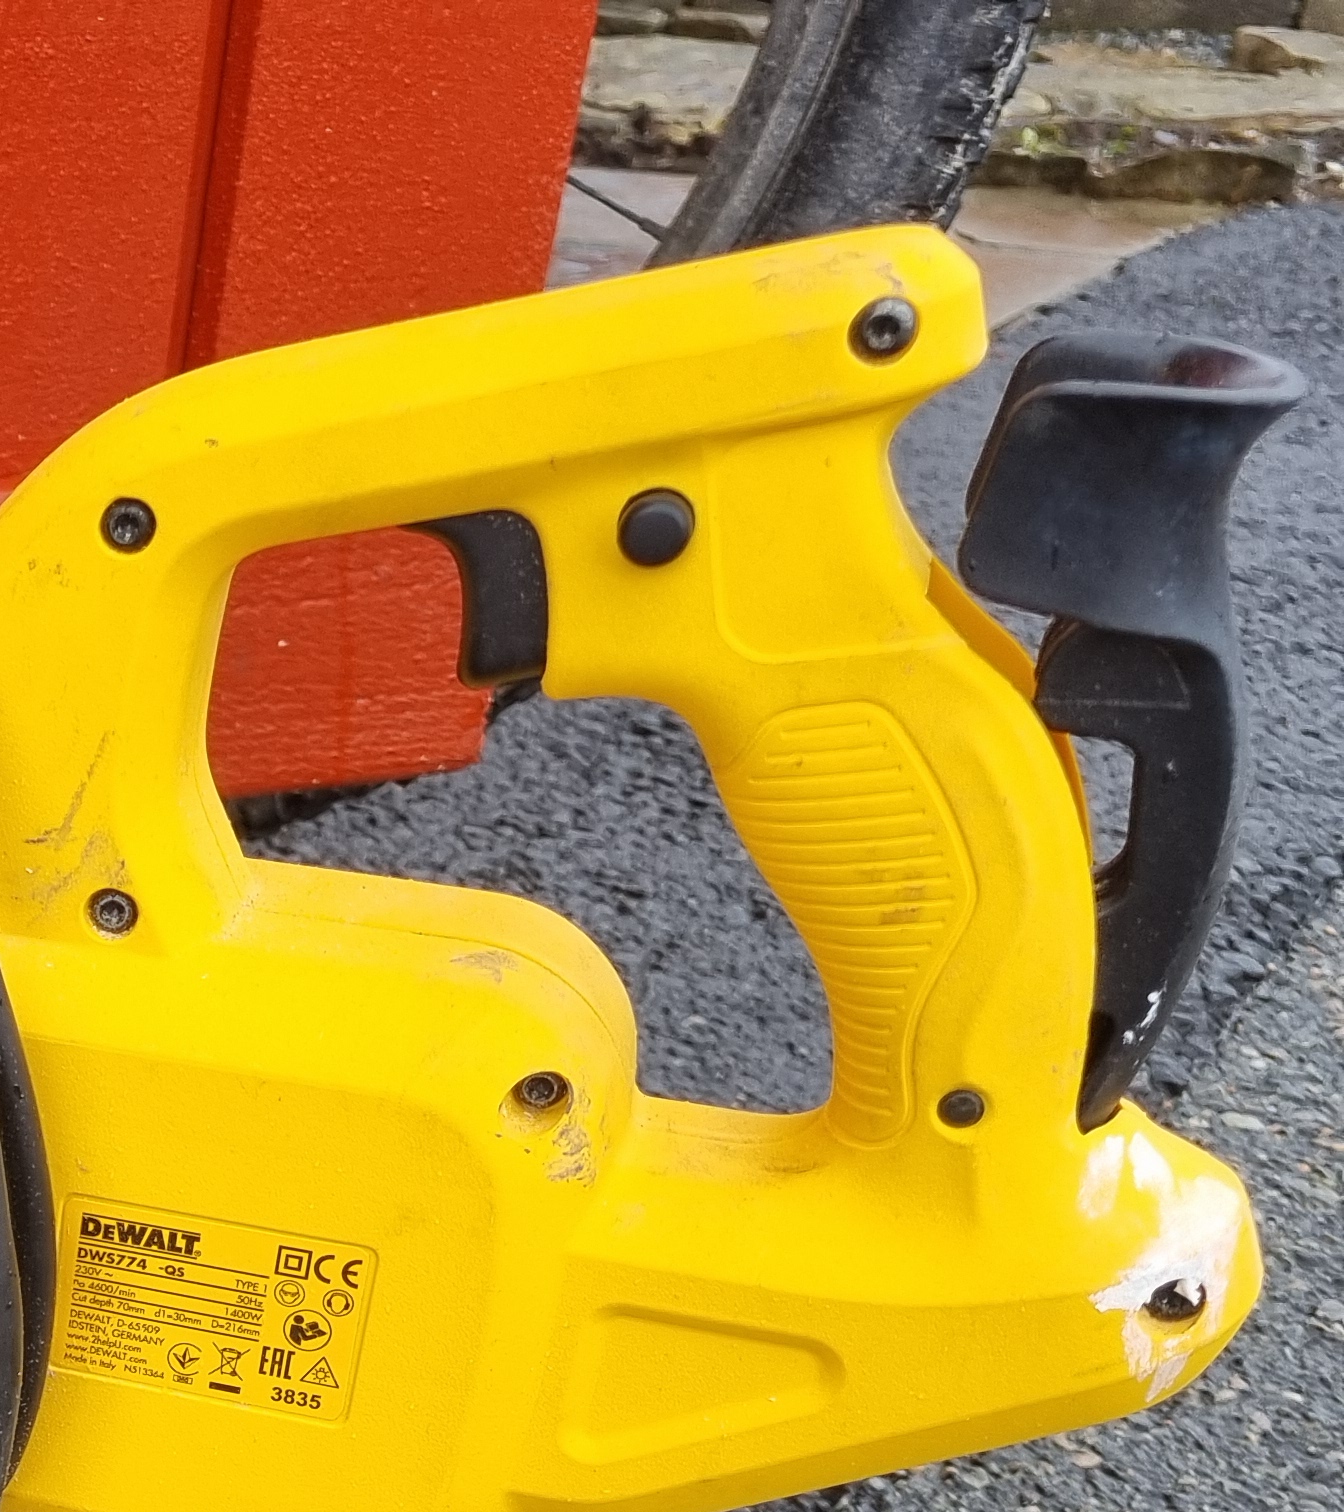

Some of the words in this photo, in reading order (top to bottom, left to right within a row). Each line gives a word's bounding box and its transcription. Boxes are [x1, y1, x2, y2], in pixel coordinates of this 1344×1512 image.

[77, 1247, 147, 1271] DWS774
[235, 1278, 259, 1292] TYPE
[75, 1264, 102, 1277] 230V
[236, 1294, 263, 1308] 50Hz
[88, 1281, 136, 1298] 4600/min
[225, 1307, 263, 1322] 1400W
[72, 1292, 87, 1303] Cut
[89, 1296, 114, 1309] depth
[116, 1301, 145, 1315] 70mm
[154, 1308, 202, 1325] d1=30mm
[211, 1320, 260, 1336] D=216mm
[66, 1332, 142, 1353] www.2helpU.com
[112, 1329, 165, 1346] GERMANY
[64, 1352, 87, 1364] Made
[90, 1357, 97, 1365] in
[99, 1359, 116, 1371] Italy
[65, 1342, 148, 1365] www.DEWALT.com
[270, 1386, 322, 1410] 3835
